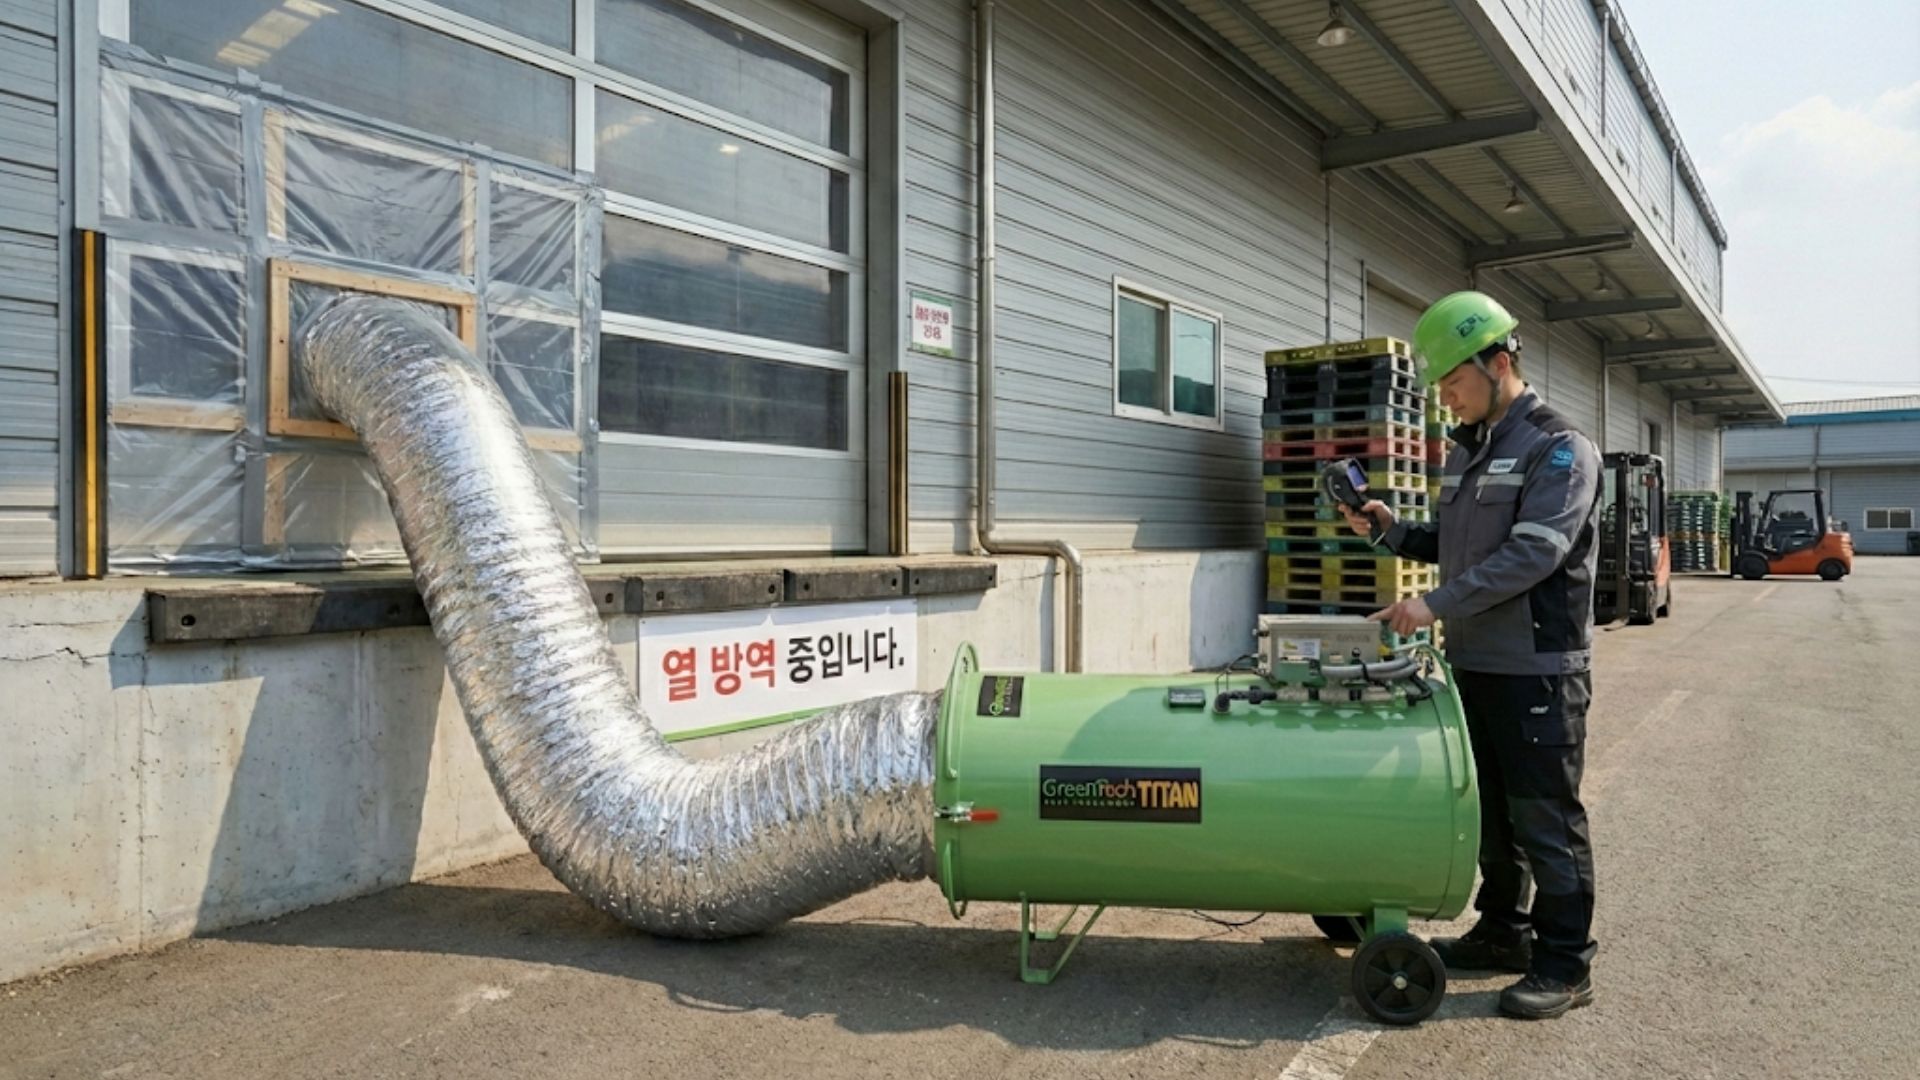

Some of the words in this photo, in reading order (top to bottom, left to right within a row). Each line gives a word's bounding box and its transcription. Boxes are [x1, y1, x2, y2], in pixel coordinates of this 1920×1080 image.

[662, 647, 697, 702] 열
[711, 638, 775, 696] 방역
[787, 626, 904, 684] 중입니다.
[1136, 780, 1199, 808] TITAN
